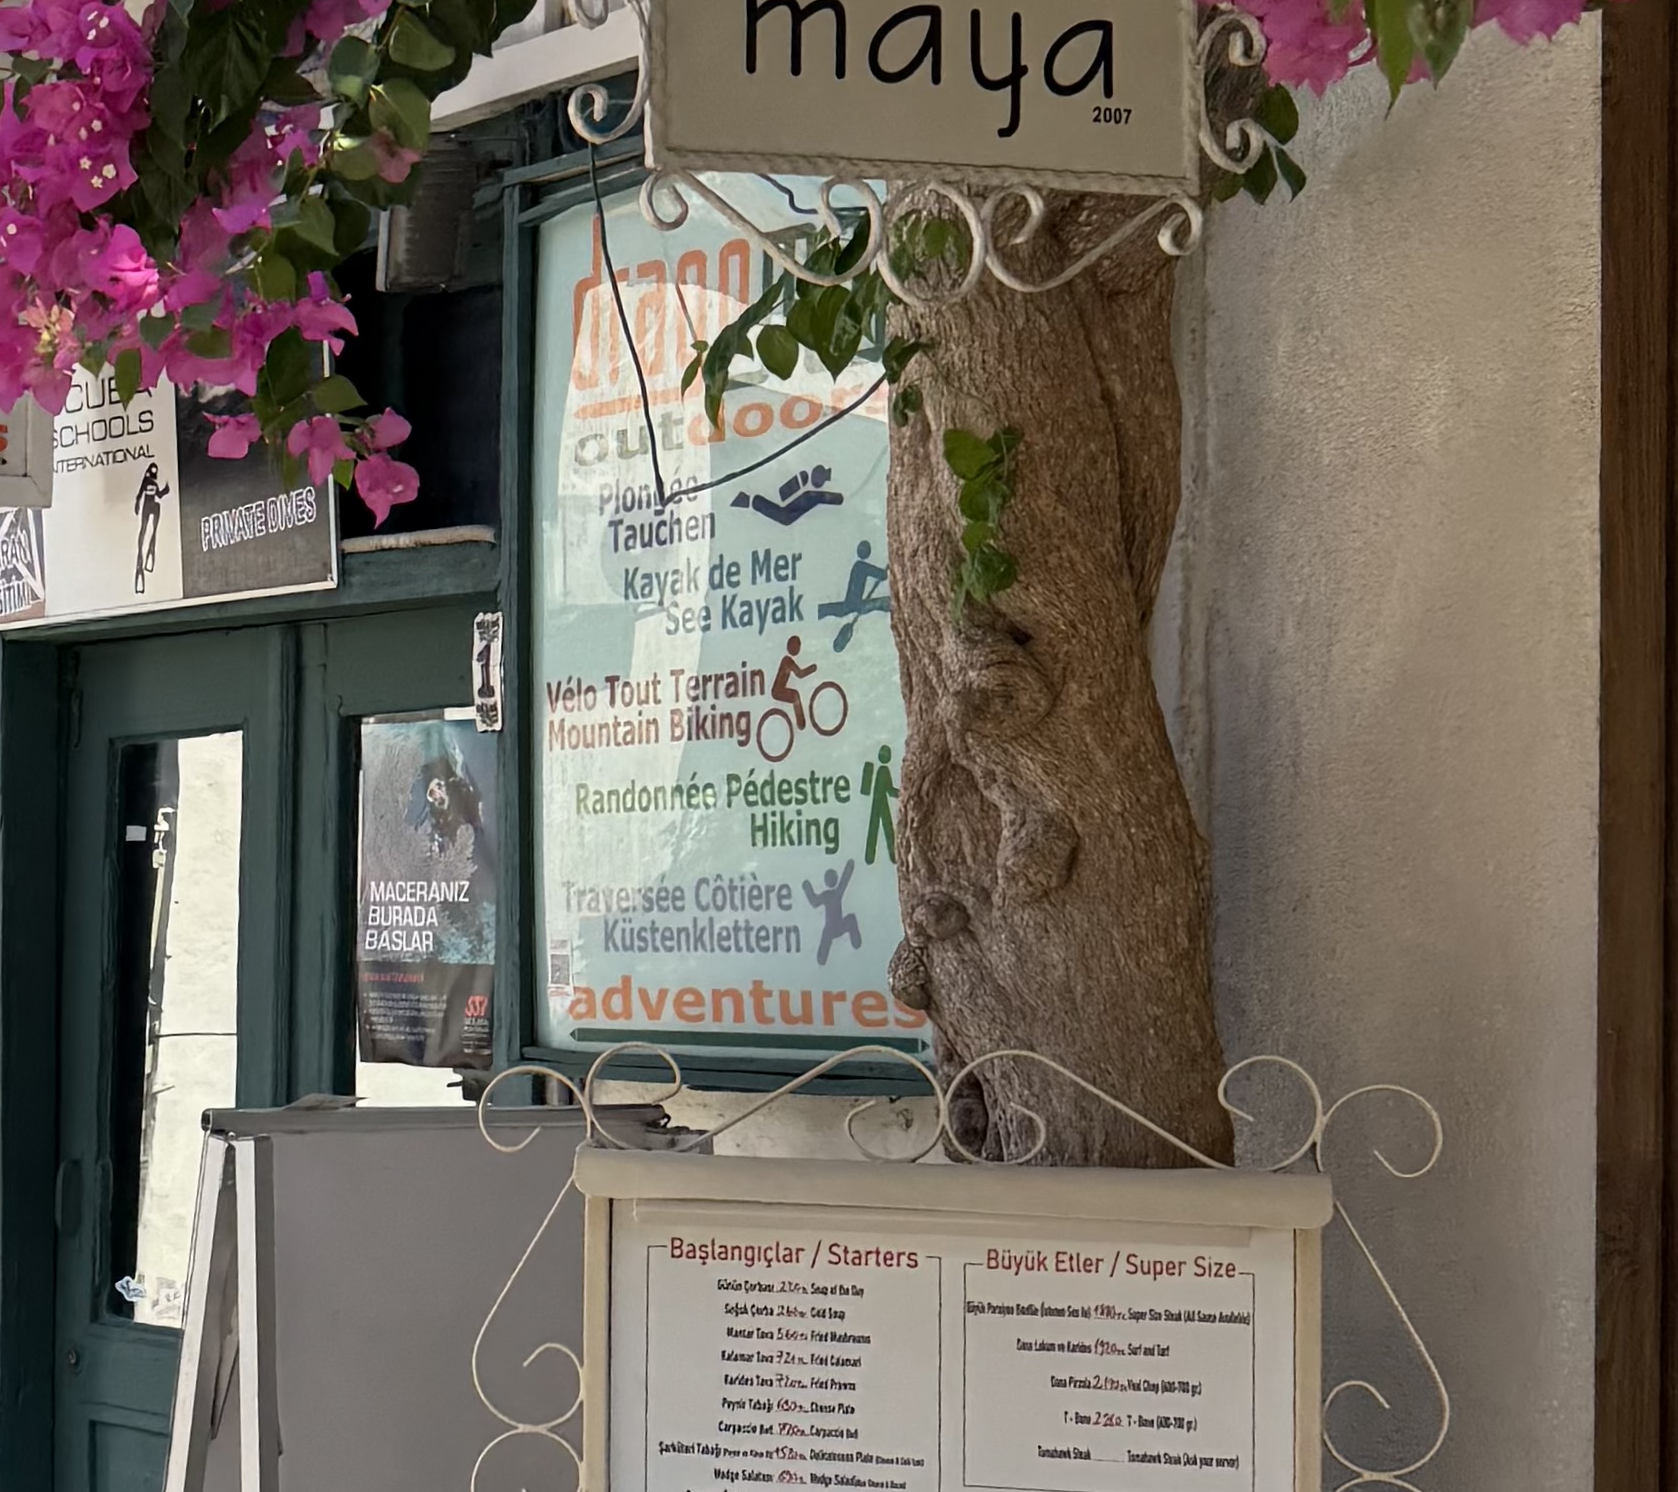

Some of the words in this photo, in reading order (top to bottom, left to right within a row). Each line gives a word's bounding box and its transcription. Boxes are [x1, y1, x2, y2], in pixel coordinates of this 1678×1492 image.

[1092, 106, 1133, 125] 2007
[53, 443, 155, 474] NTERNATIONAL
[201, 500, 266, 552] PRIVATE
[267, 486, 317, 533] DIVES
[607, 512, 716, 554] Tauchen
[624, 564, 699, 612] Kayak
[708, 553, 741, 590] de
[751, 549, 802, 585] Mer
[665, 598, 711, 637] See
[721, 588, 804, 633] Kayak
[547, 676, 597, 714] Vélo
[605, 672, 662, 707] Tout
[670, 661, 765, 703] Terrain
[548, 712, 659, 752] Mountain
[670, 708, 752, 747] Biking
[576, 773, 717, 816] Randonnée
[726, 768, 851, 810] Pédestre
[751, 810, 840, 855] Hiking
[370, 881, 470, 903] MACERANIZ
[563, 875, 686, 914] Traversée
[694, 872, 793, 912] Côtière
[368, 905, 438, 927] BURADA
[604, 917, 802, 955] Küstenklettern
[568, 975, 930, 1029] adventures
[671, 1237, 805, 1268] Başlangıçlar
[811, 1240, 822, 1268] /
[828, 1243, 918, 1268] Starters
[987, 1249, 1048, 1276] Büyük
[1055, 1251, 1104, 1273] Etler
[1110, 1251, 1120, 1277] /
[1126, 1253, 1186, 1281] Super
[1194, 1256, 1236, 1278] Size
